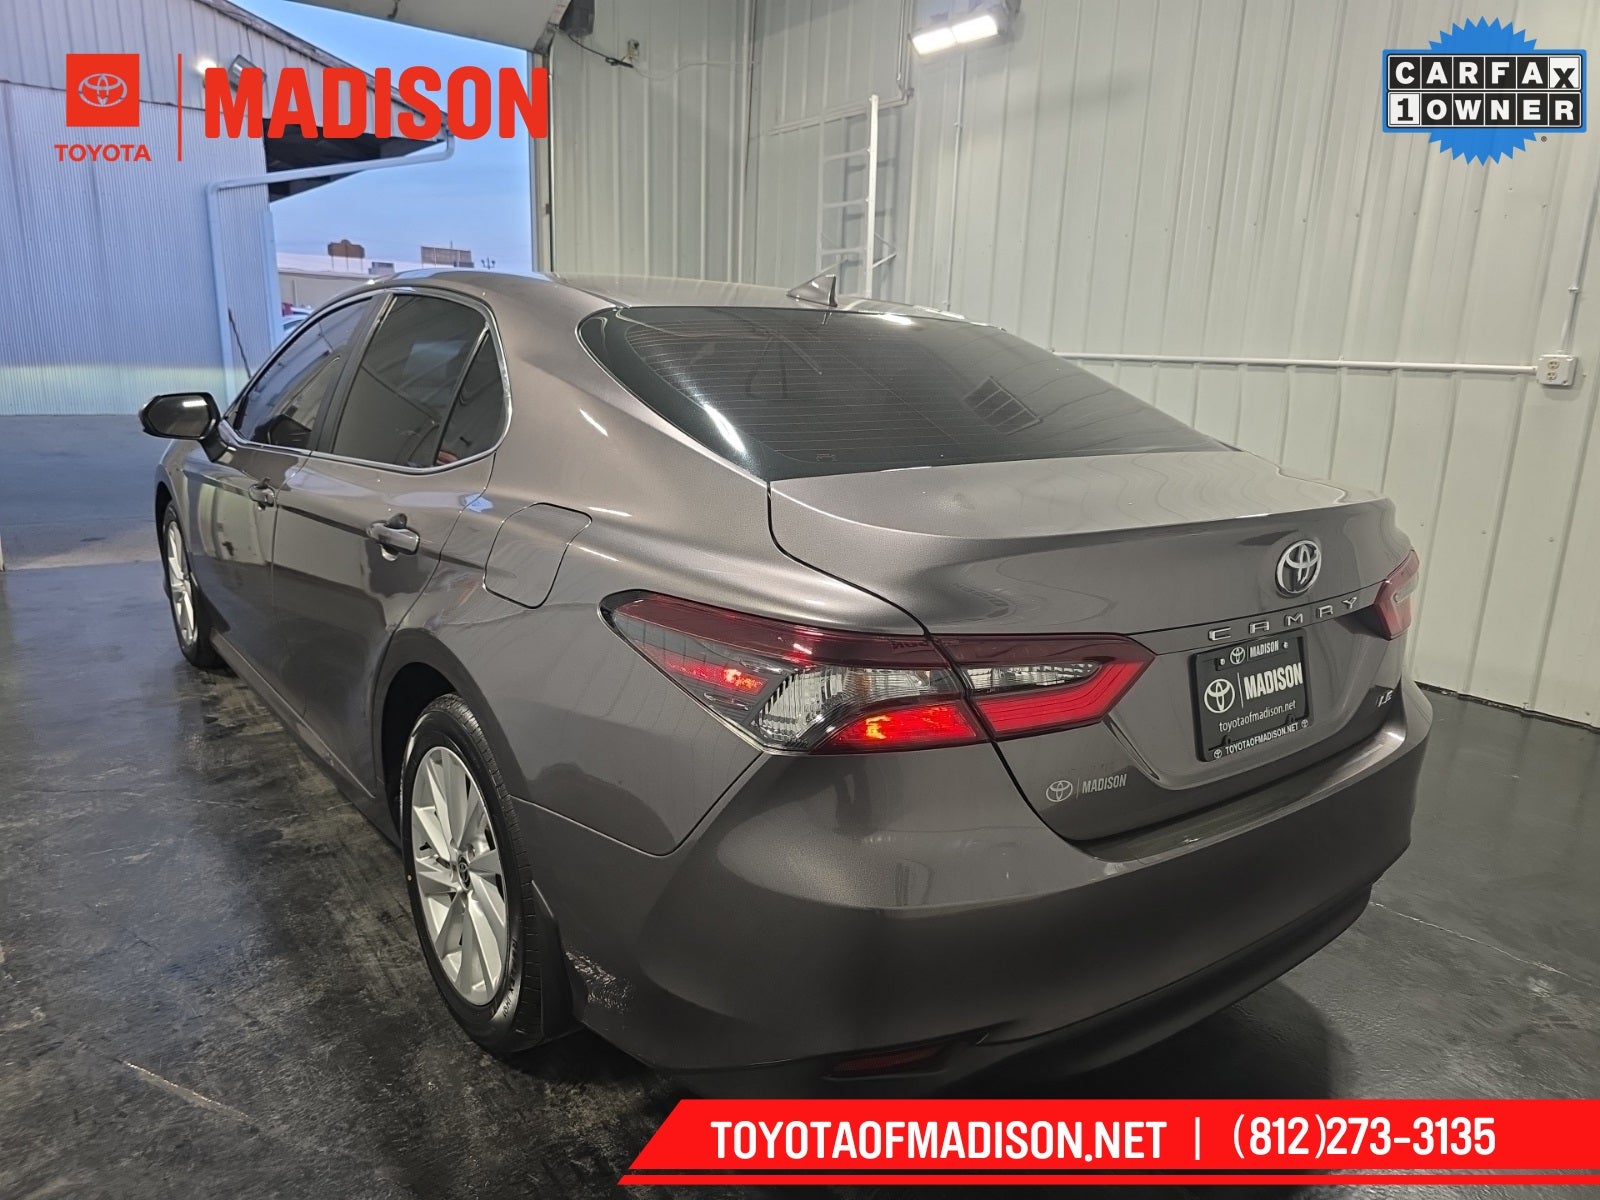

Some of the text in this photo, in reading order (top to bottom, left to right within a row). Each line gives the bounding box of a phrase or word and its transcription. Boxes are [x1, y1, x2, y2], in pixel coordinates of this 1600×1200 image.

[1208, 596, 1358, 641] CAMRY
[1249, 640, 1279, 658] MADISON
[1243, 662, 1304, 700] MADISON
[1218, 700, 1296, 733] toyotaofmadison.net
[1225, 722, 1299, 755] TOYOTAOFMADISON.NET
[1081, 773, 1127, 794] MADISON
